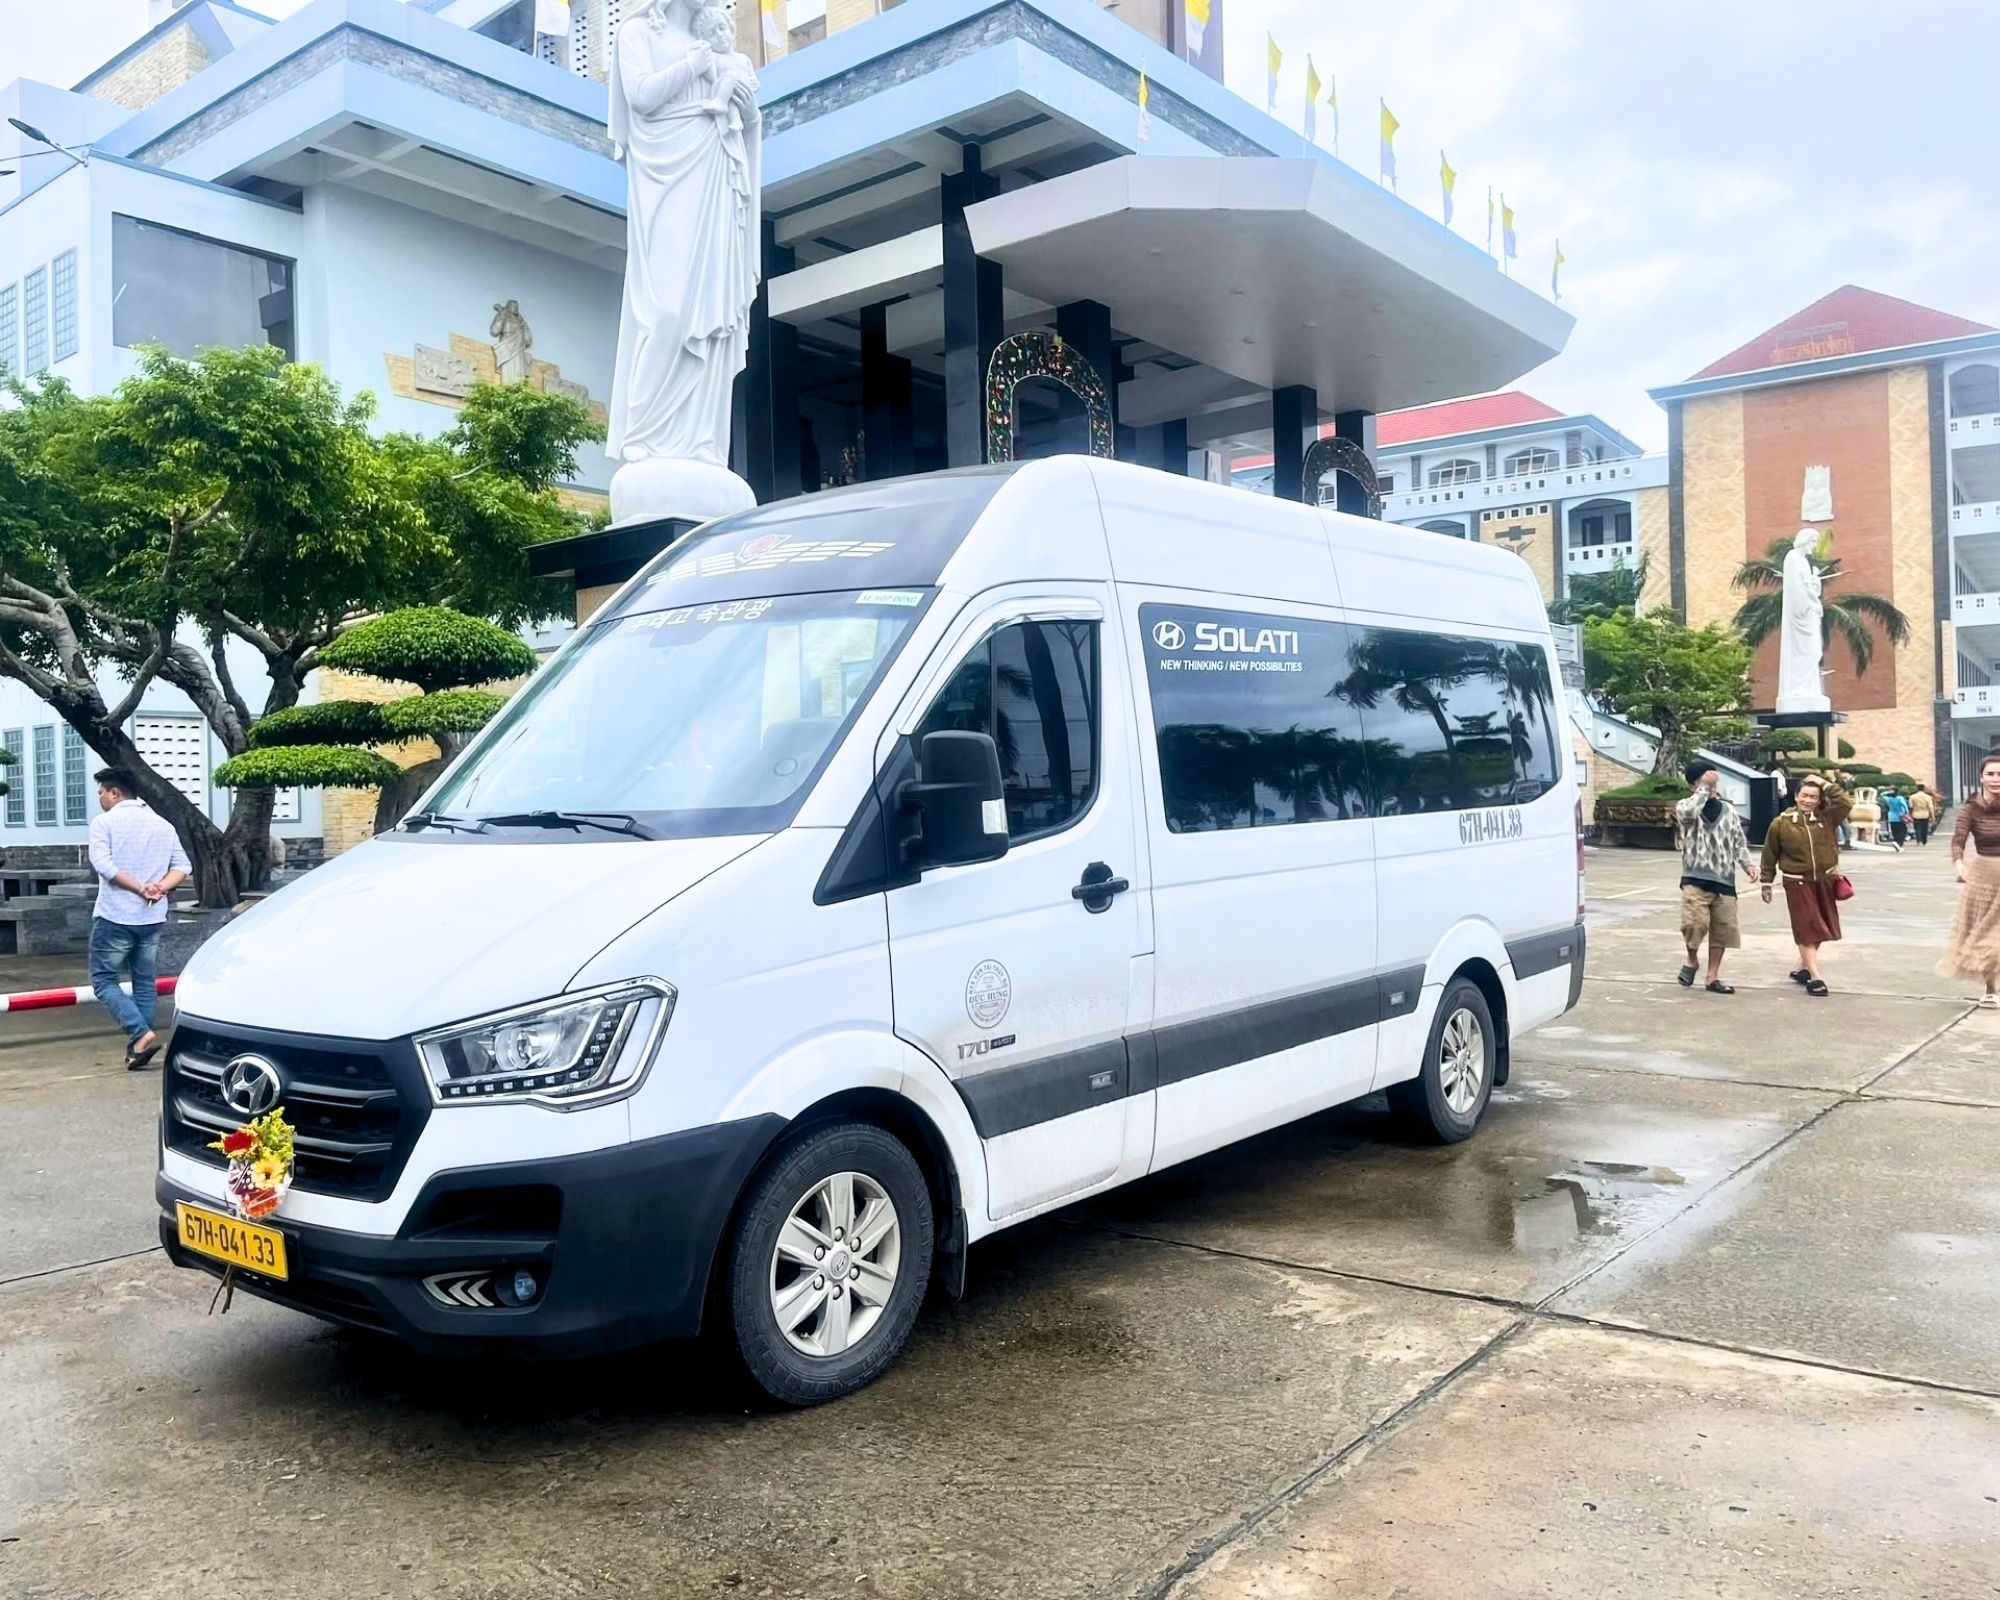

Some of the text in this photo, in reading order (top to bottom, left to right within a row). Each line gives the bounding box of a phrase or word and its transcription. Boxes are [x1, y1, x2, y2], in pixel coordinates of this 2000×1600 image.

[1193, 623, 1298, 654] SOLATI
[1161, 659, 1181, 671] NEW
[1184, 660, 1223, 672] THINKING
[1229, 661, 1247, 672] NEW
[1459, 808, 1522, 844] 67H-041.33
[185, 1213, 275, 1267] 67H-041.33
